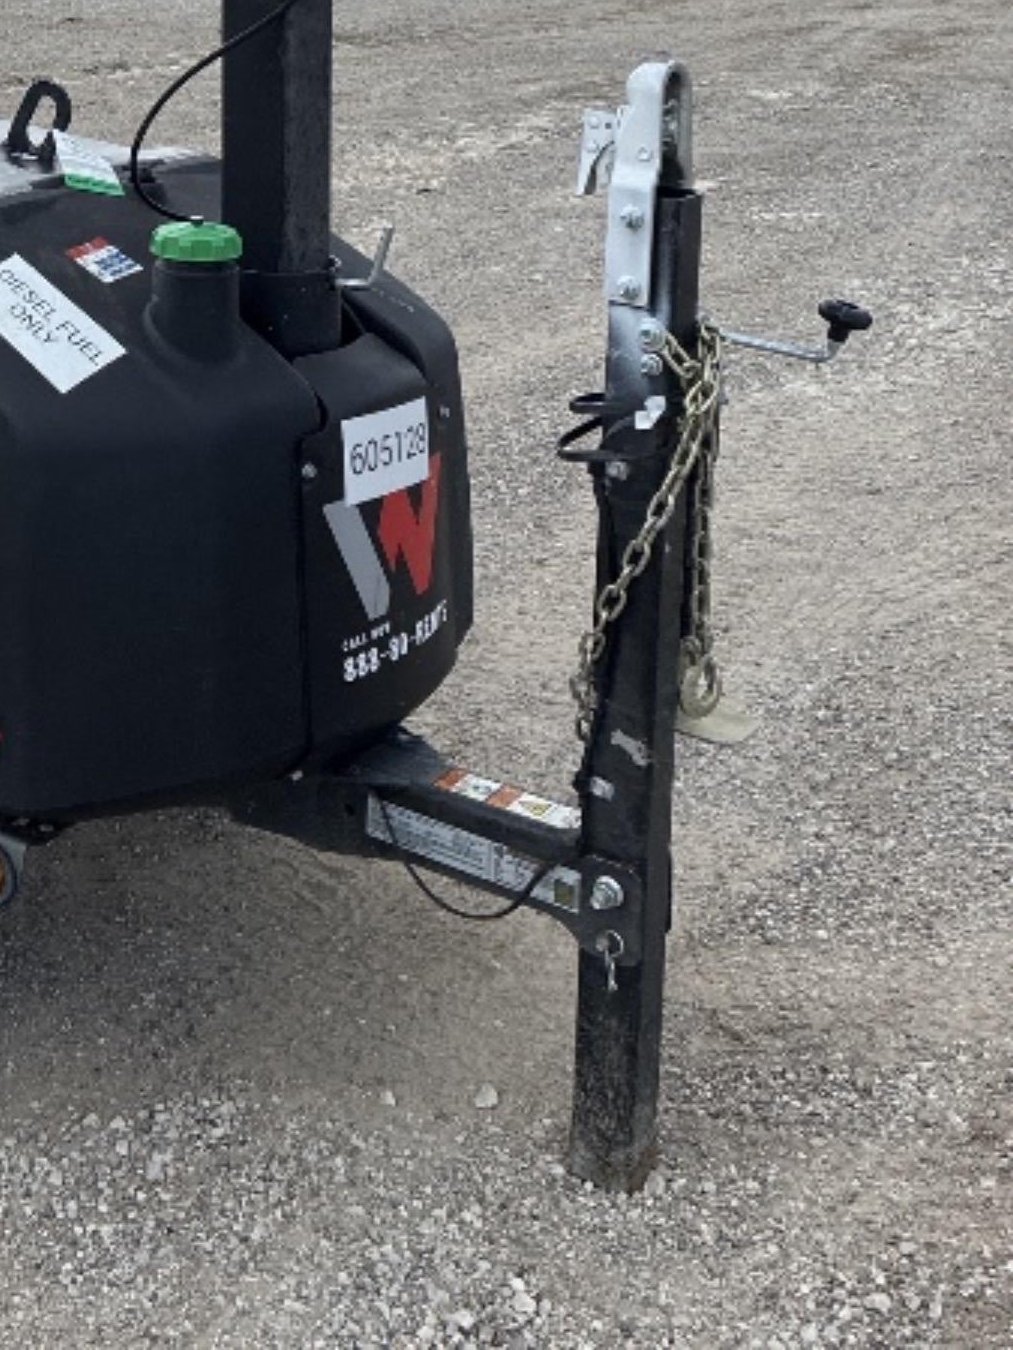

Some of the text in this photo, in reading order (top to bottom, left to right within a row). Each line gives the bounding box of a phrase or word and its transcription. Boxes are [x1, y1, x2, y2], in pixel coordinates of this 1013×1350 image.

[9, 302, 60, 345] ONLY
[55, 319, 104, 367] FUEL
[349, 422, 426, 476] 605128
